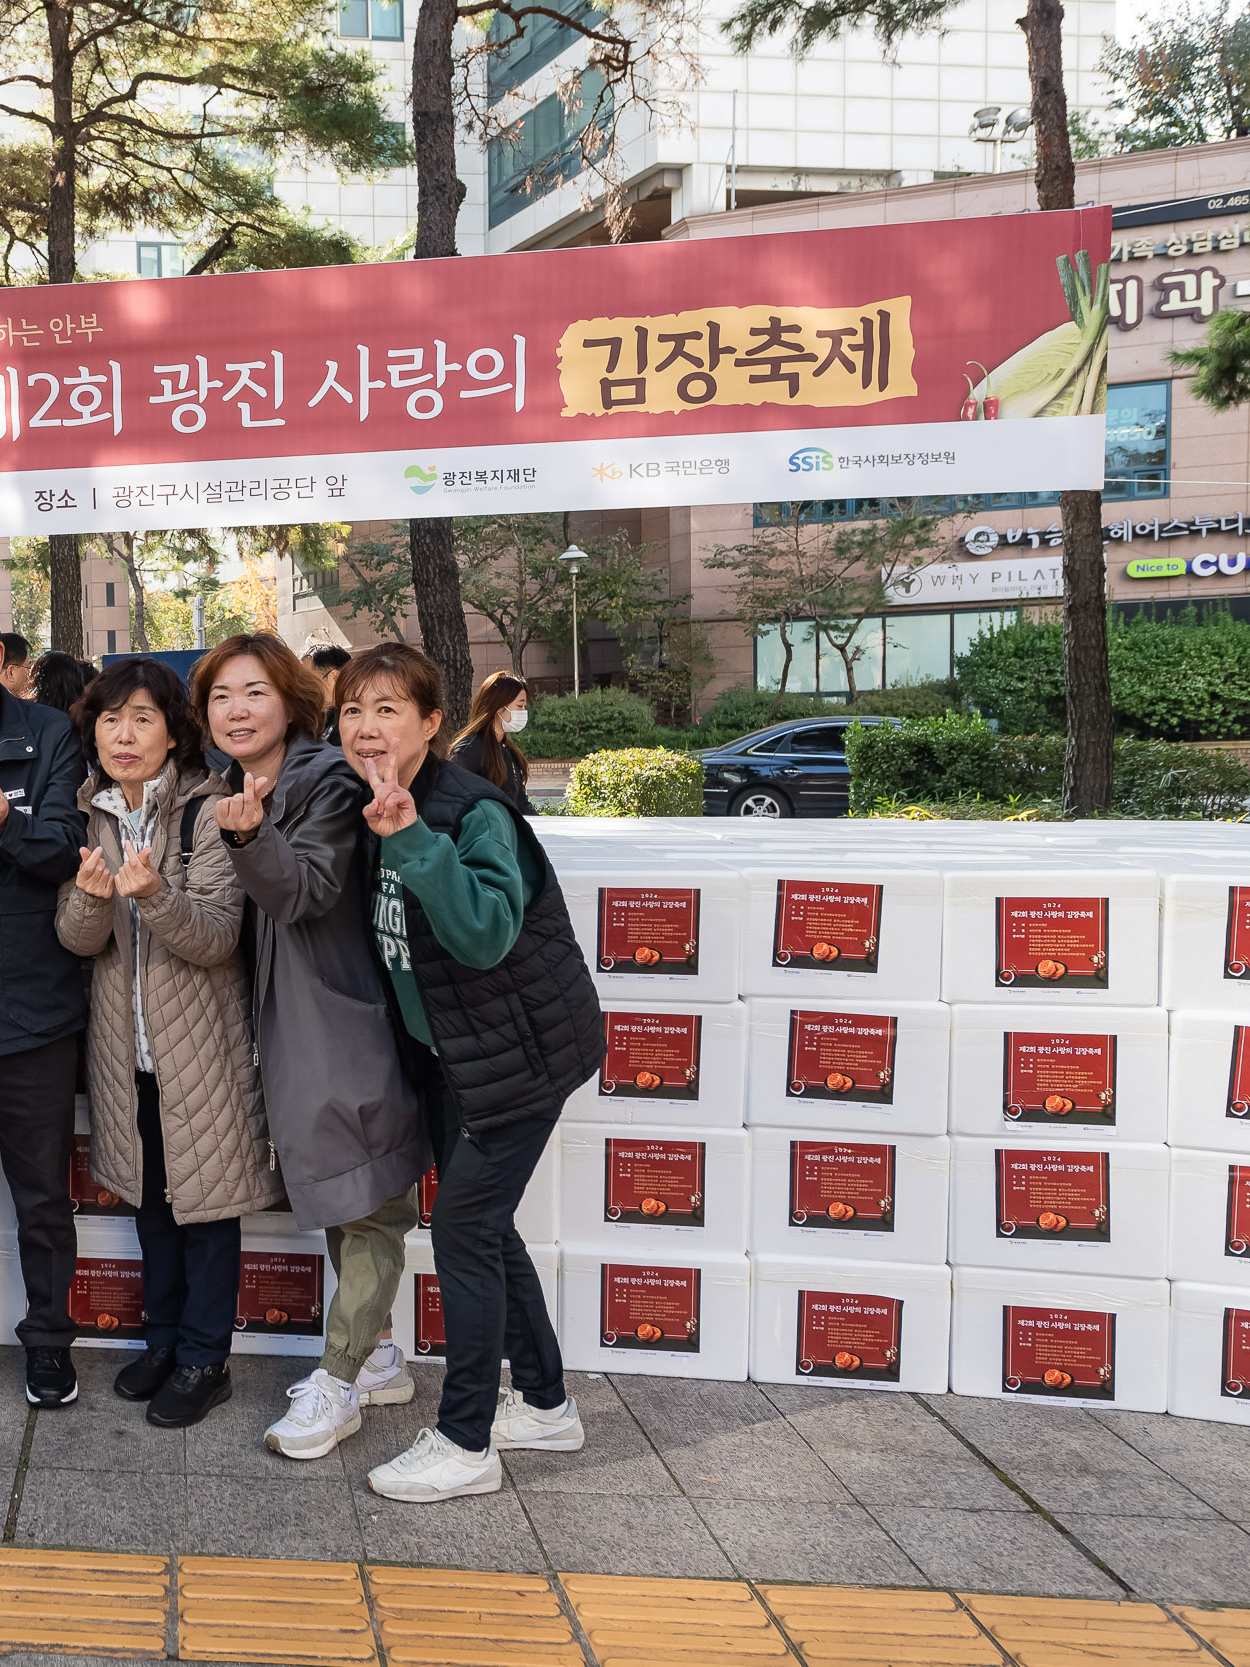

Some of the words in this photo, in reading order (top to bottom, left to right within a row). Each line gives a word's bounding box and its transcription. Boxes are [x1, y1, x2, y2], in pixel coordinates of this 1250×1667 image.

[1111, 236, 1155, 262] 가족
[49, 312, 104, 345] 안부
[148, 348, 286, 434] 광진
[307, 332, 527, 422] 사랑의
[582, 308, 892, 410] 김장축제
[838, 451, 956, 470] 한국사회보장정보원
[442, 466, 538, 486] 광진복지재단
[34, 488, 78, 512] 장소
[112, 478, 317, 508] 광진구시설관리공단
[324, 474, 348, 498] 앞
[1136, 563, 1163, 572] Nice
[1166, 563, 1179, 572] to
[1192, 552, 1246, 576] CU
[931, 572, 980, 587] WHY
[991, 568, 1061, 584] PILAT
[791, 894, 807, 902] 제2회
[808, 894, 821, 903] 광진
[822, 895, 841, 904] 사랑의
[842, 896, 868, 905] 김장축제
[1011, 910, 1028, 919] 제2회
[1029, 911, 1043, 919] 광진
[1044, 911, 1065, 919] 사랑의
[1066, 911, 1094, 919] 김장축제
[804, 1024, 821, 1033] 제2회
[822, 1025, 835, 1033] 광진
[836, 1026, 855, 1034] 사랑의
[857, 1027, 882, 1036] 김장축제
[1019, 1046, 1036, 1054] 제2회
[1037, 1046, 1051, 1055] 광진
[1052, 1047, 1073, 1055] 사랑의
[1074, 1047, 1102, 1055] 김장축제
[1011, 1163, 1028, 1171] 제2회
[1029, 1163, 1043, 1172] 광진
[1044, 1164, 1065, 1172] 사랑의
[1067, 1164, 1094, 1173] 김장축제
[1018, 1320, 1035, 1328] 제2회
[1036, 1320, 1050, 1329] 광진
[1051, 1321, 1071, 1330] 사랑의
[1073, 1322, 1100, 1331] 김장축제
